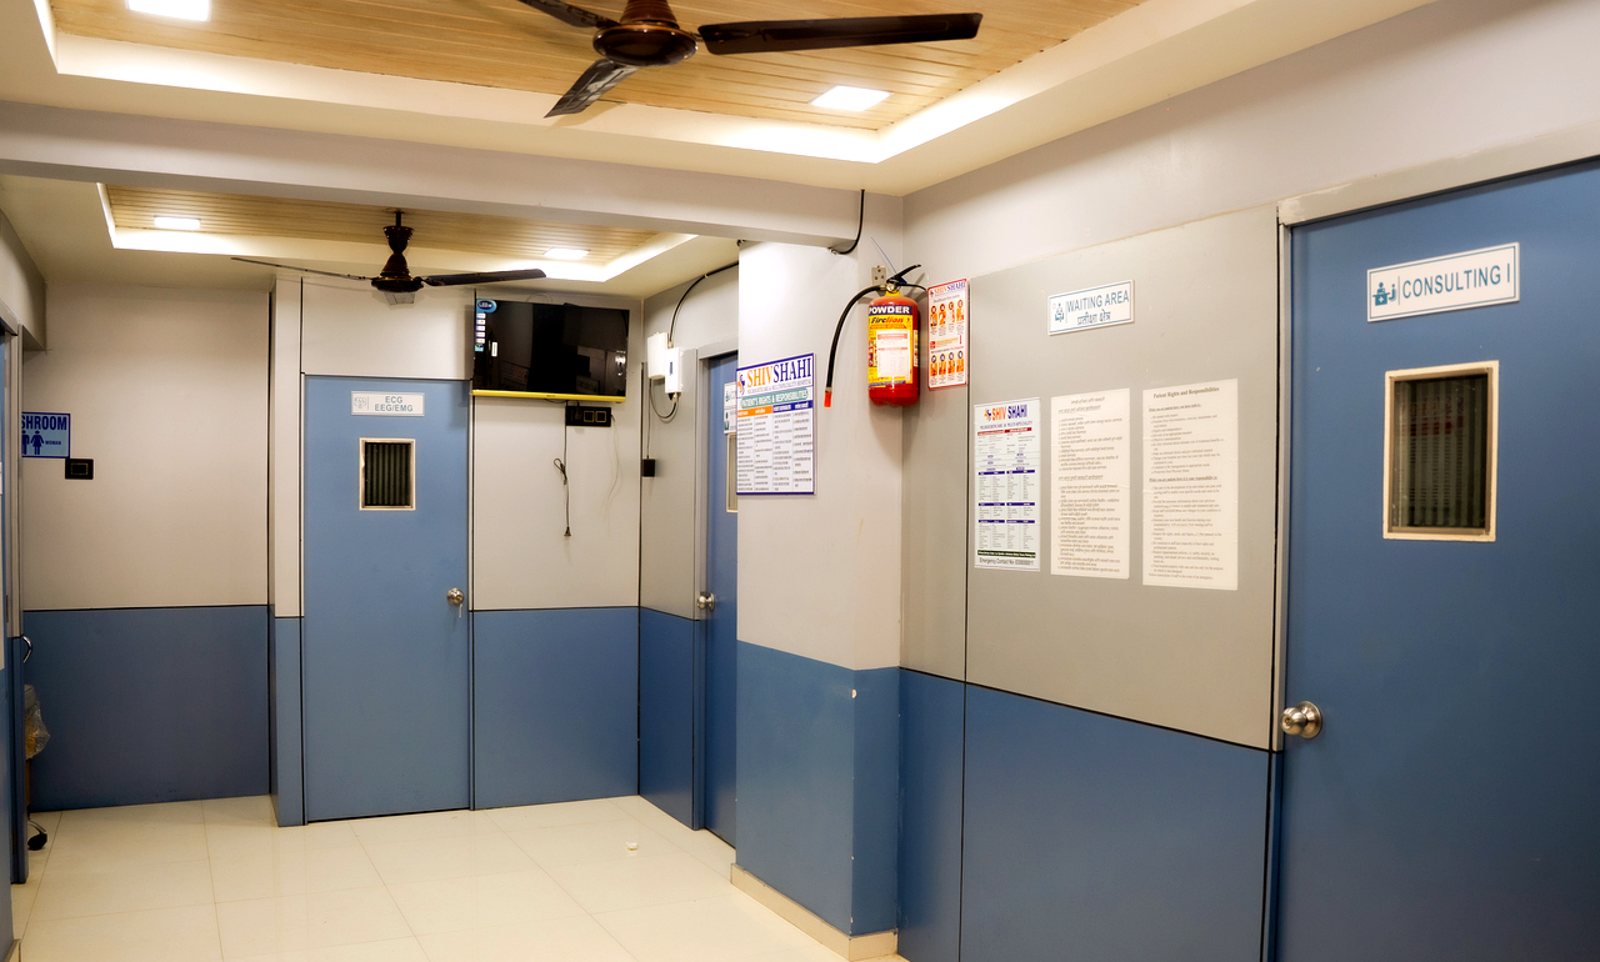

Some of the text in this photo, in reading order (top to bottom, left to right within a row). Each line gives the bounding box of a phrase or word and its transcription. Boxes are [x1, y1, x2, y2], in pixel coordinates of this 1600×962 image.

[1402, 263, 1510, 299] CONSULTING I
[1067, 290, 1129, 312] WAITING AREA
[374, 404, 413, 412] EEG/EMG
[385, 396, 403, 404] ECG
[992, 404, 1028, 421] SHIV SHAHI
